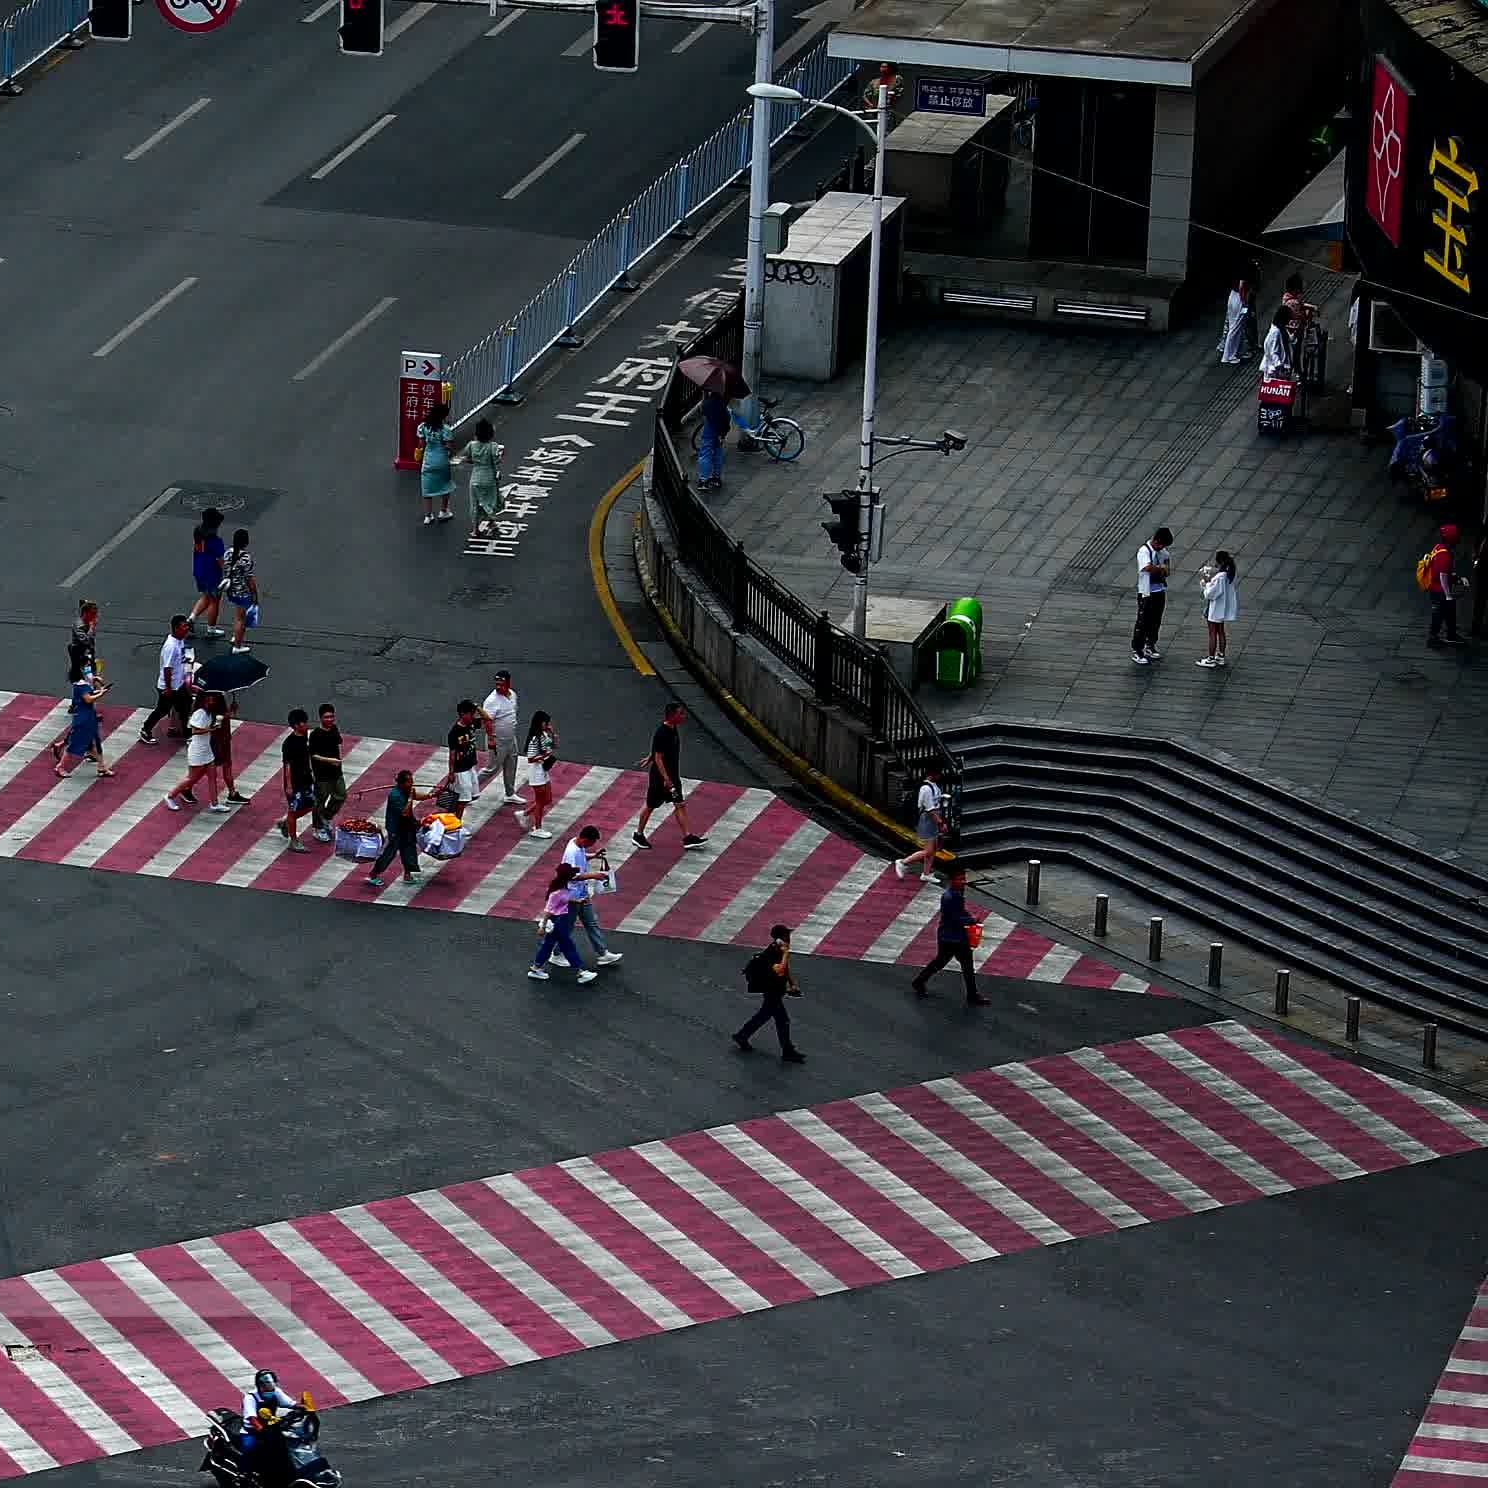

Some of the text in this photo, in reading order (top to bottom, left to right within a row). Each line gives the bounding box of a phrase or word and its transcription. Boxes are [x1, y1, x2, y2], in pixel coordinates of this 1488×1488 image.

[405, 359, 417, 372] P
[1261, 386, 1290, 397] HUNAN
[405, 383, 419, 420] 王府井
